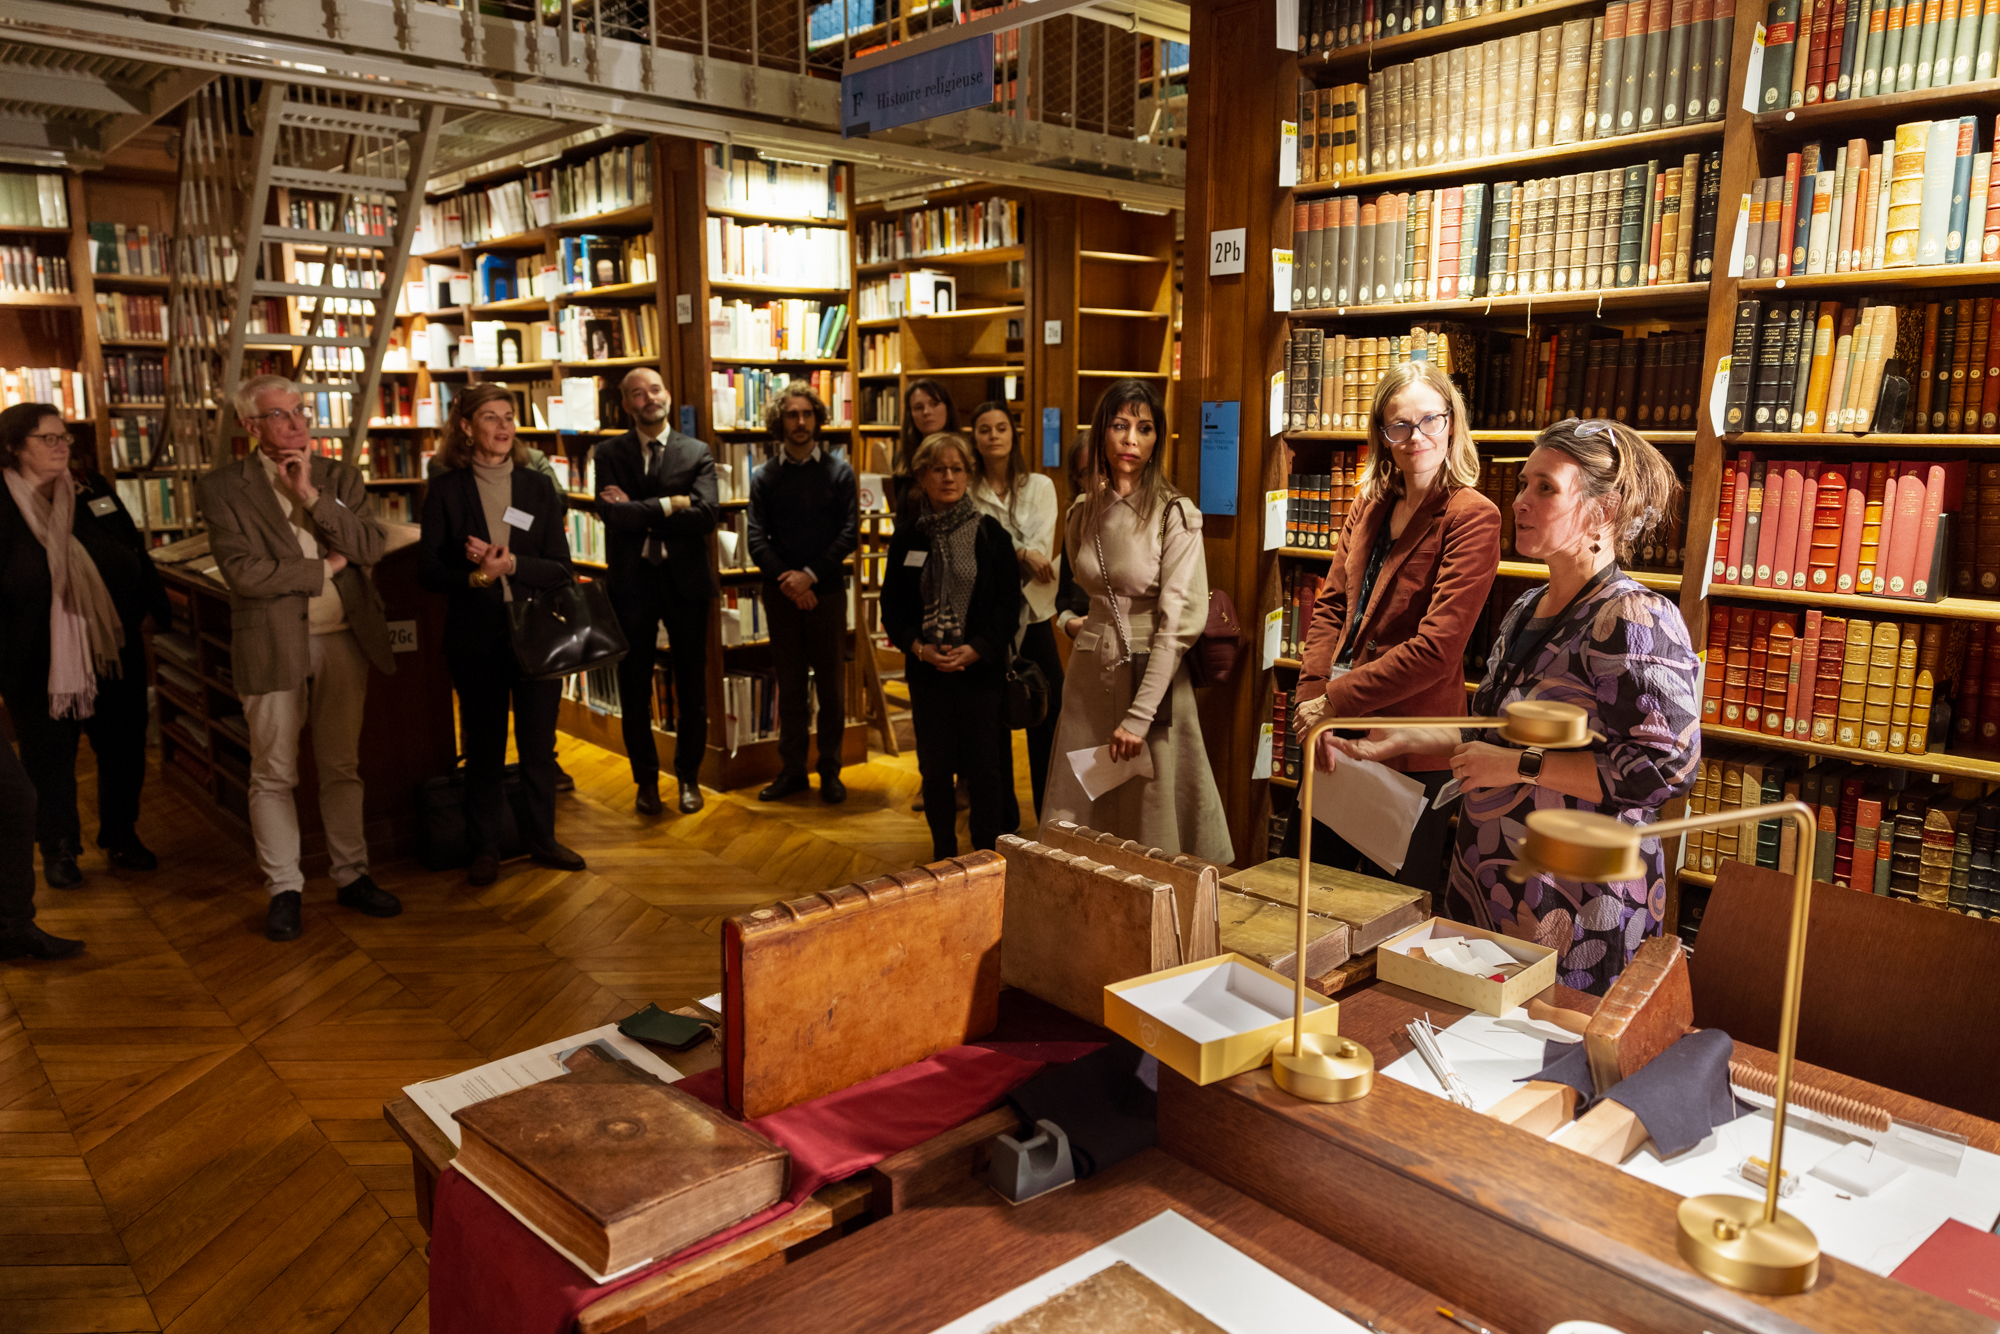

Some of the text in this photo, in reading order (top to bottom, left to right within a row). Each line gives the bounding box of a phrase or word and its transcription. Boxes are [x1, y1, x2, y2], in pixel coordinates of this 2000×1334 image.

[852, 71, 983, 117] F Histoire religieuse
[1215, 240, 1241, 263] 2Pb
[1204, 412, 1212, 423] F
[389, 629, 414, 645] 2Gc
